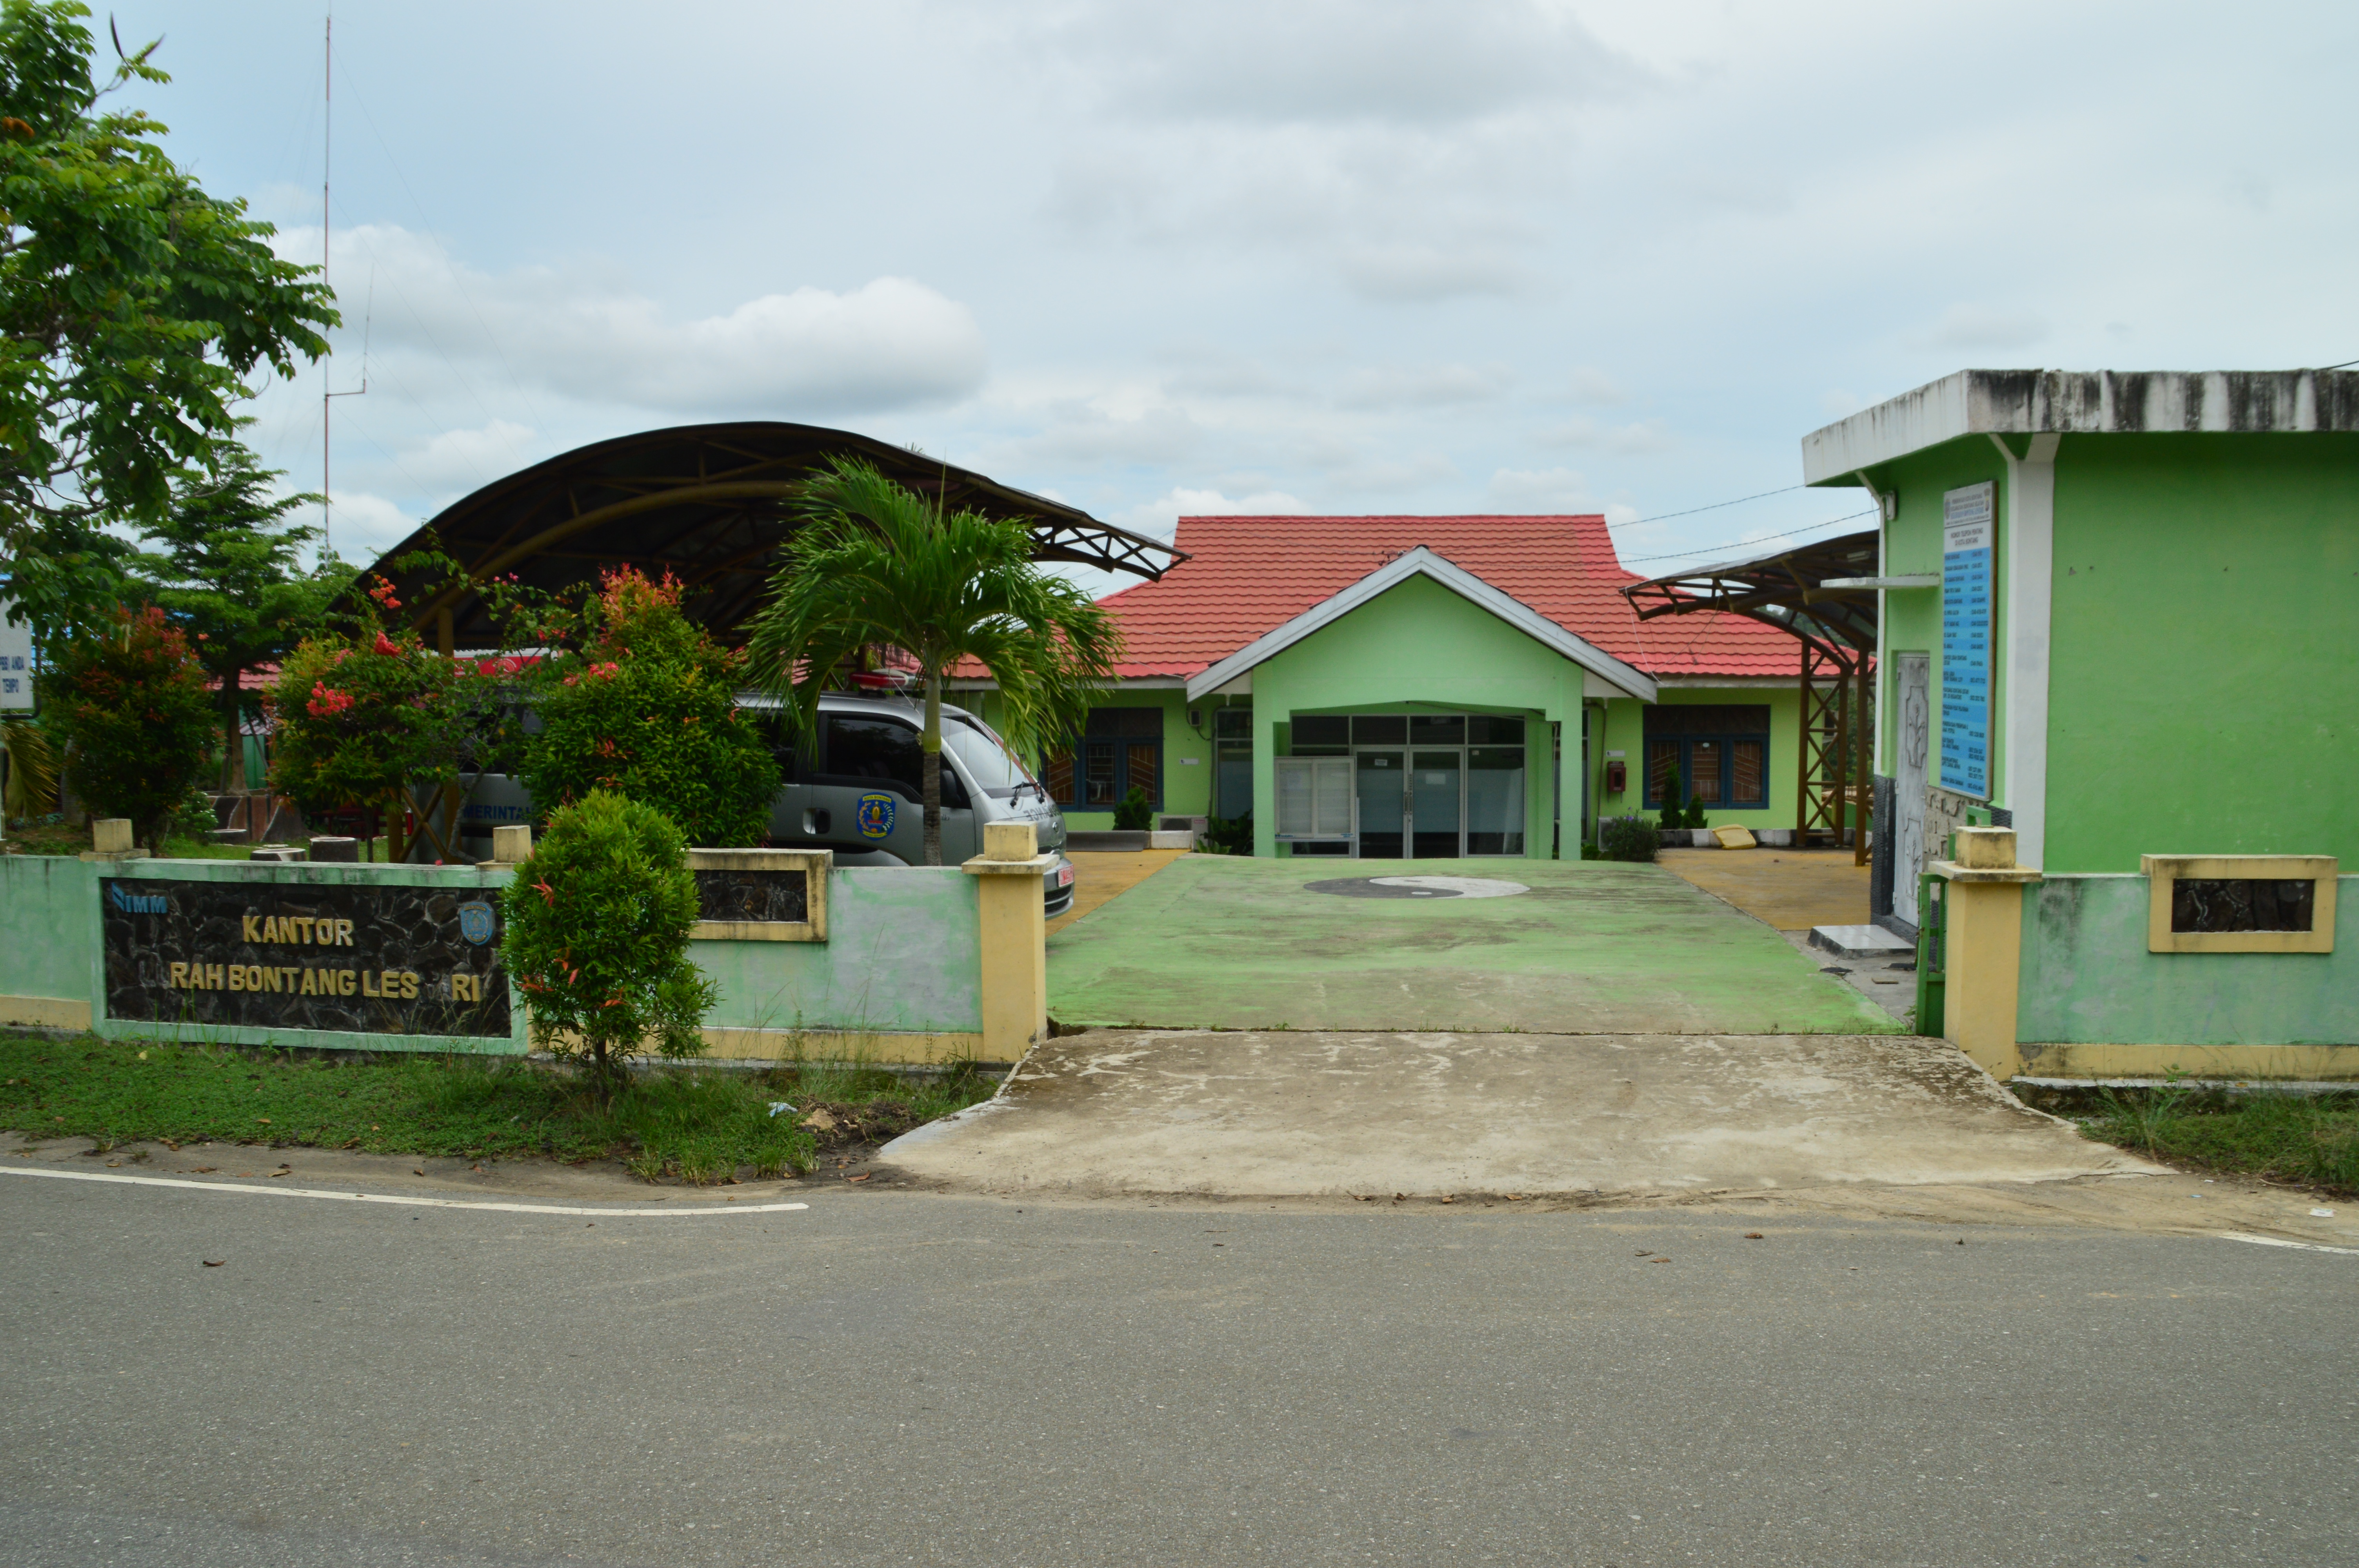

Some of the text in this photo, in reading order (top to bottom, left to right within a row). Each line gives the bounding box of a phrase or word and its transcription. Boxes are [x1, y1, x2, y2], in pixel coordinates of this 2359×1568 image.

[463, 804, 532, 820] MERINTA
[243, 916, 354, 946] KANTOR
[229, 965, 356, 996] BONTANG
